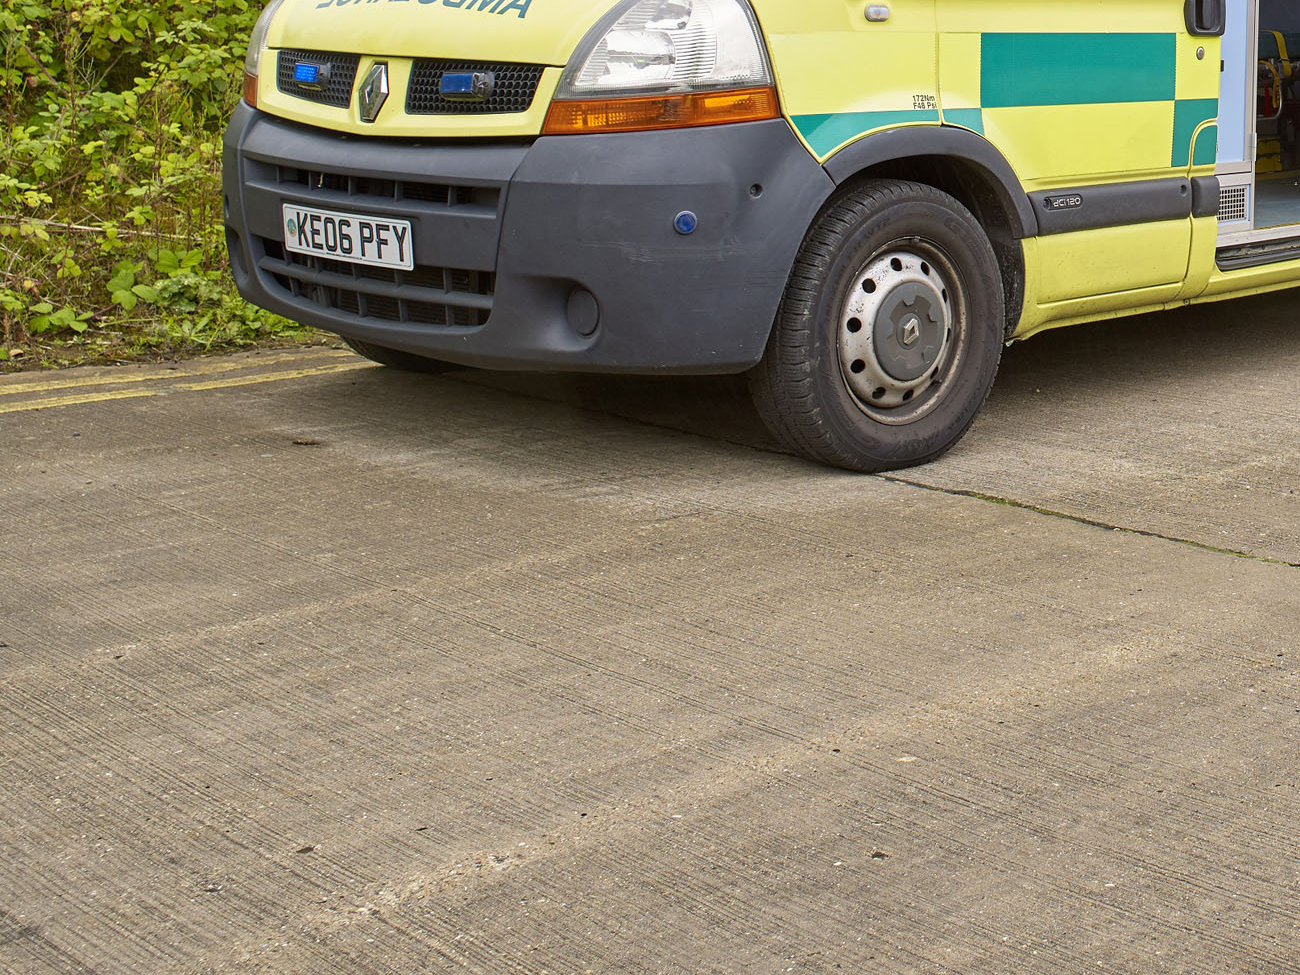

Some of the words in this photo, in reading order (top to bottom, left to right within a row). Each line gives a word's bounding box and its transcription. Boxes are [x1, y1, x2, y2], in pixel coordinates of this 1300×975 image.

[913, 94, 935, 102] 172Nm
[296, 211, 353, 255] KE06
[358, 221, 408, 262] PFY
